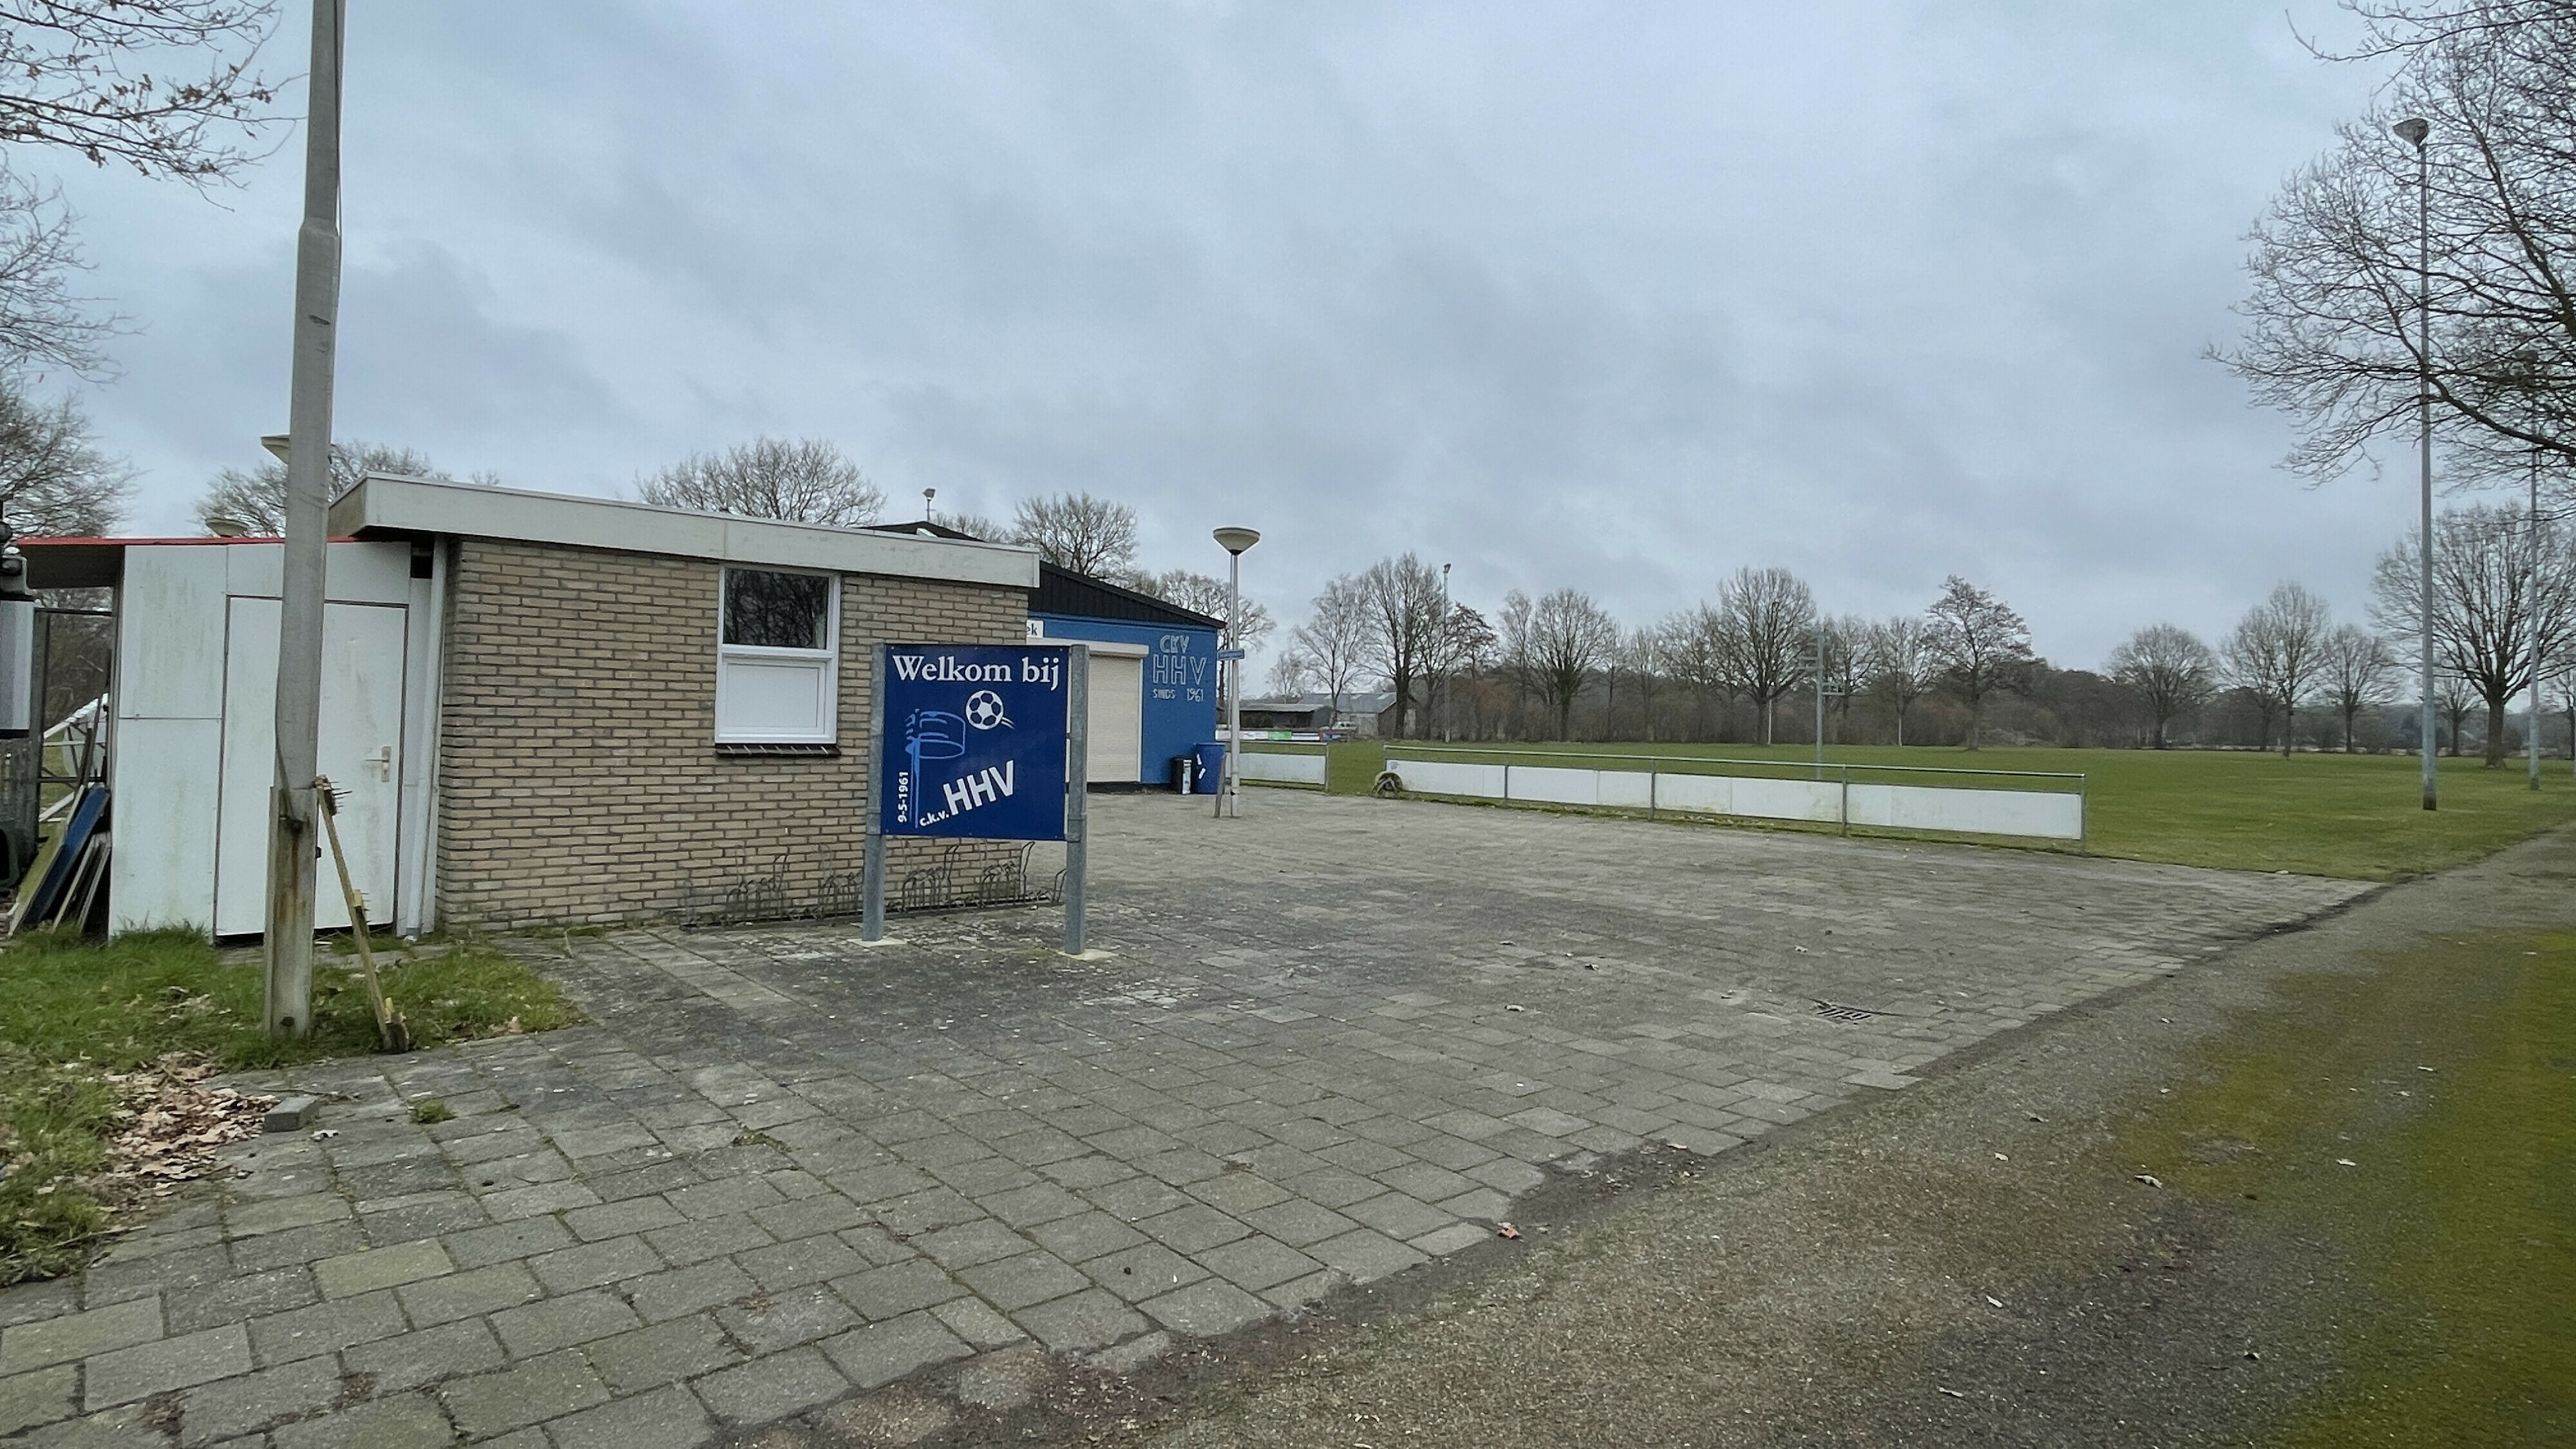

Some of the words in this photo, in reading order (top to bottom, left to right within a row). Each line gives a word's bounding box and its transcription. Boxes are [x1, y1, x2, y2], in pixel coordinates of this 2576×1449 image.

[1159, 634, 1190, 654] CKV
[892, 654, 1012, 682] Welkom
[1021, 656, 1060, 691] bij
[1152, 654, 1208, 686] HHV
[1186, 687, 1204, 703] 1961
[897, 771, 909, 824] 9-5-1961
[919, 810, 950, 827] c.k.v.
[942, 759, 1014, 816] HHV
